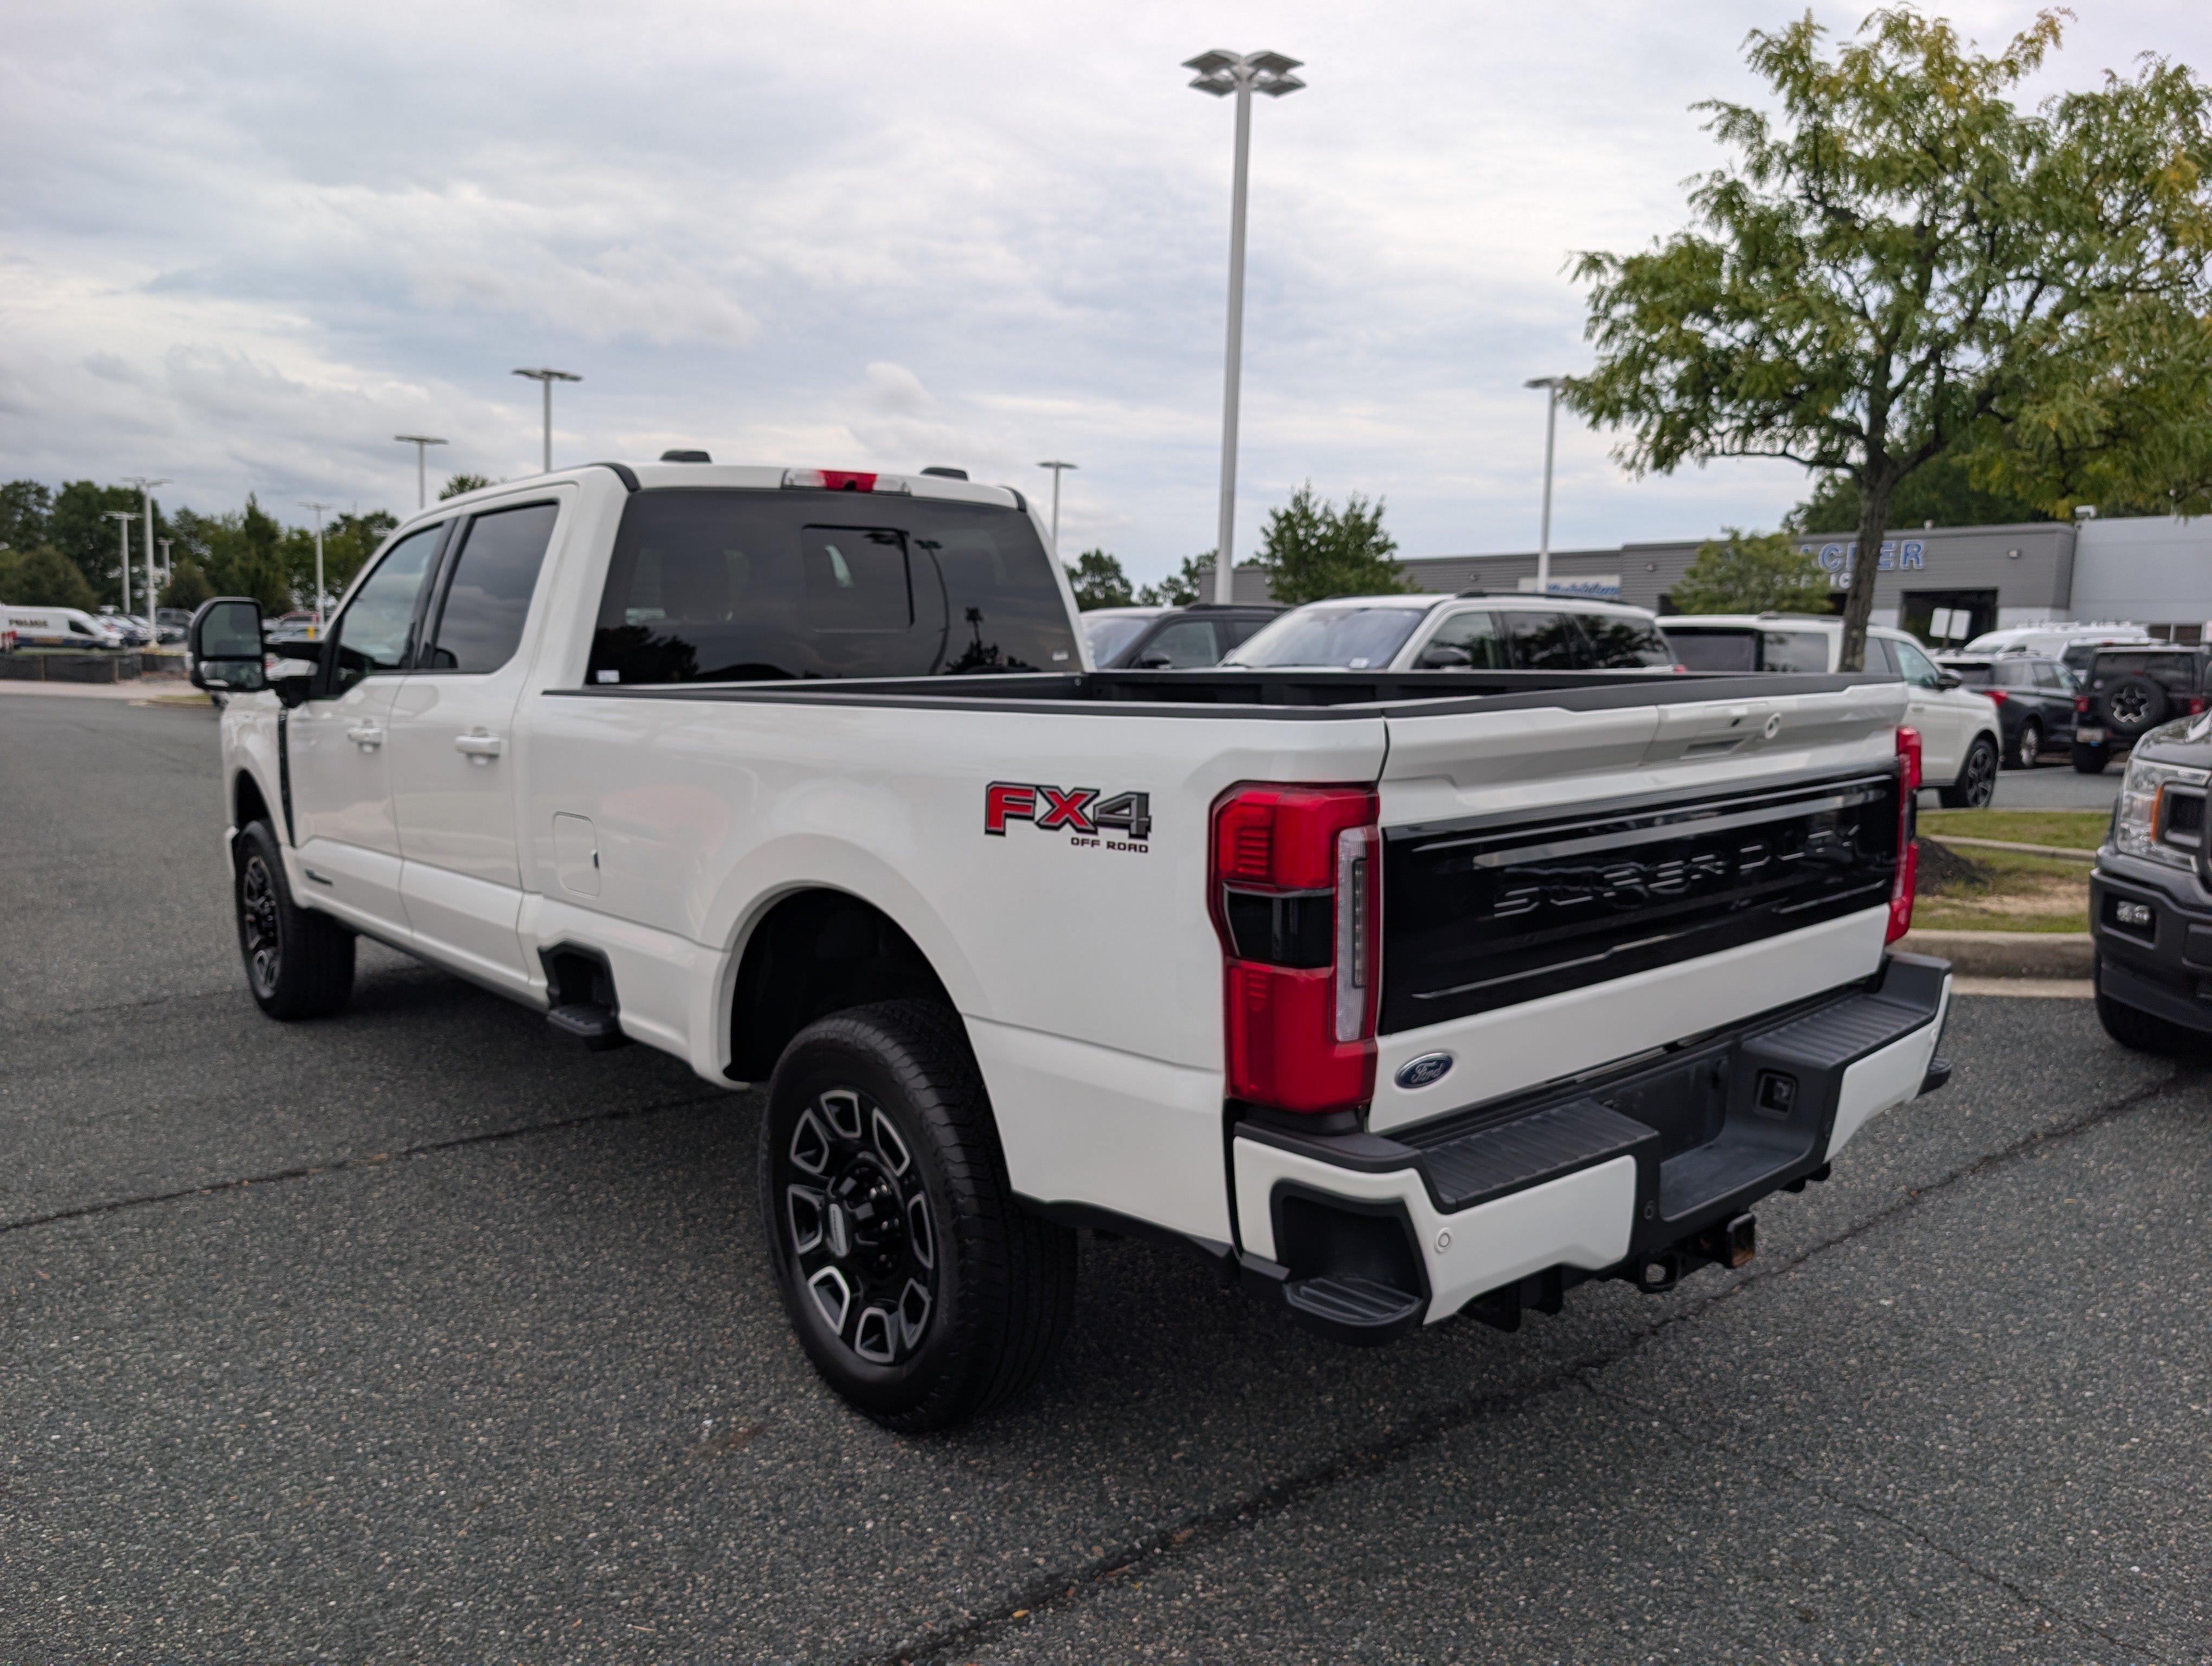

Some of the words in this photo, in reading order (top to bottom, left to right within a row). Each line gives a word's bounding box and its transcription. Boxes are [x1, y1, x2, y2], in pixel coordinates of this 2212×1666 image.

[985, 780, 1152, 841] FX4
[1071, 837, 1100, 848] OFF
[1107, 841, 1148, 854] ROAD
[1411, 1061, 1444, 1084] Ford
